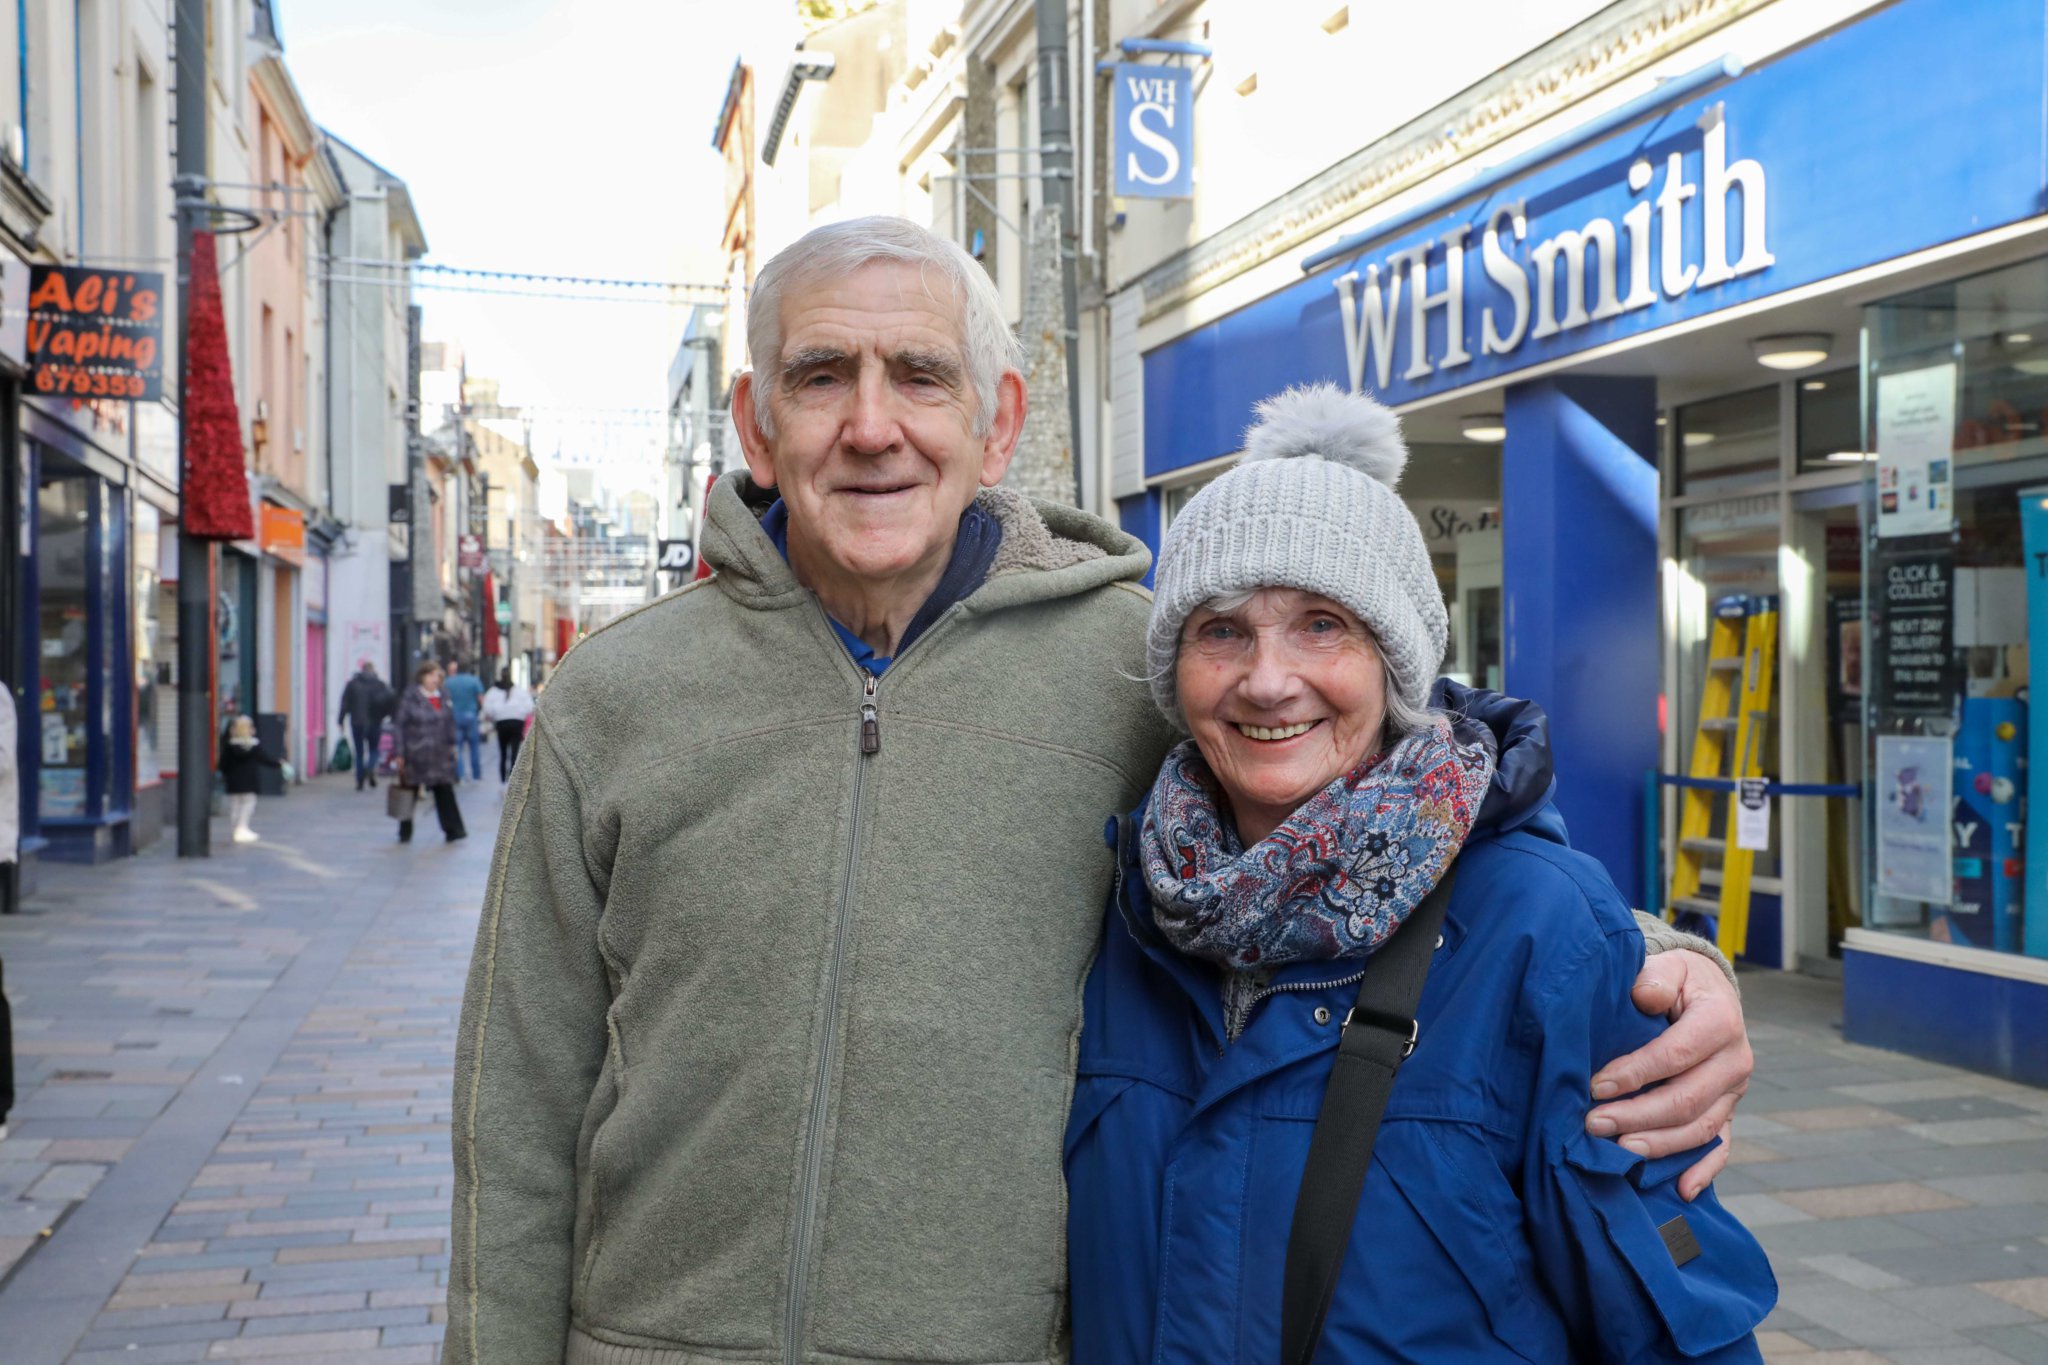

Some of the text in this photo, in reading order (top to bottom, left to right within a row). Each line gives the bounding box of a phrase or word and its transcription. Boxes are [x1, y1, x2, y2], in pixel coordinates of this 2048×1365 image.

[1127, 77, 1177, 104] WH
[1128, 102, 1180, 185] S
[1333, 100, 1775, 392] WHSmith
[30, 272, 158, 321] Ali's
[27, 320, 156, 369] Vaping
[35, 368, 145, 397] 679359
[659, 543, 691, 567] JD
[1888, 563, 1940, 583] CLICK &
[1888, 581, 1948, 601] COLLECT
[1890, 618, 1945, 634] NEXT DAY
[1890, 634, 1944, 650] DELIVERY
